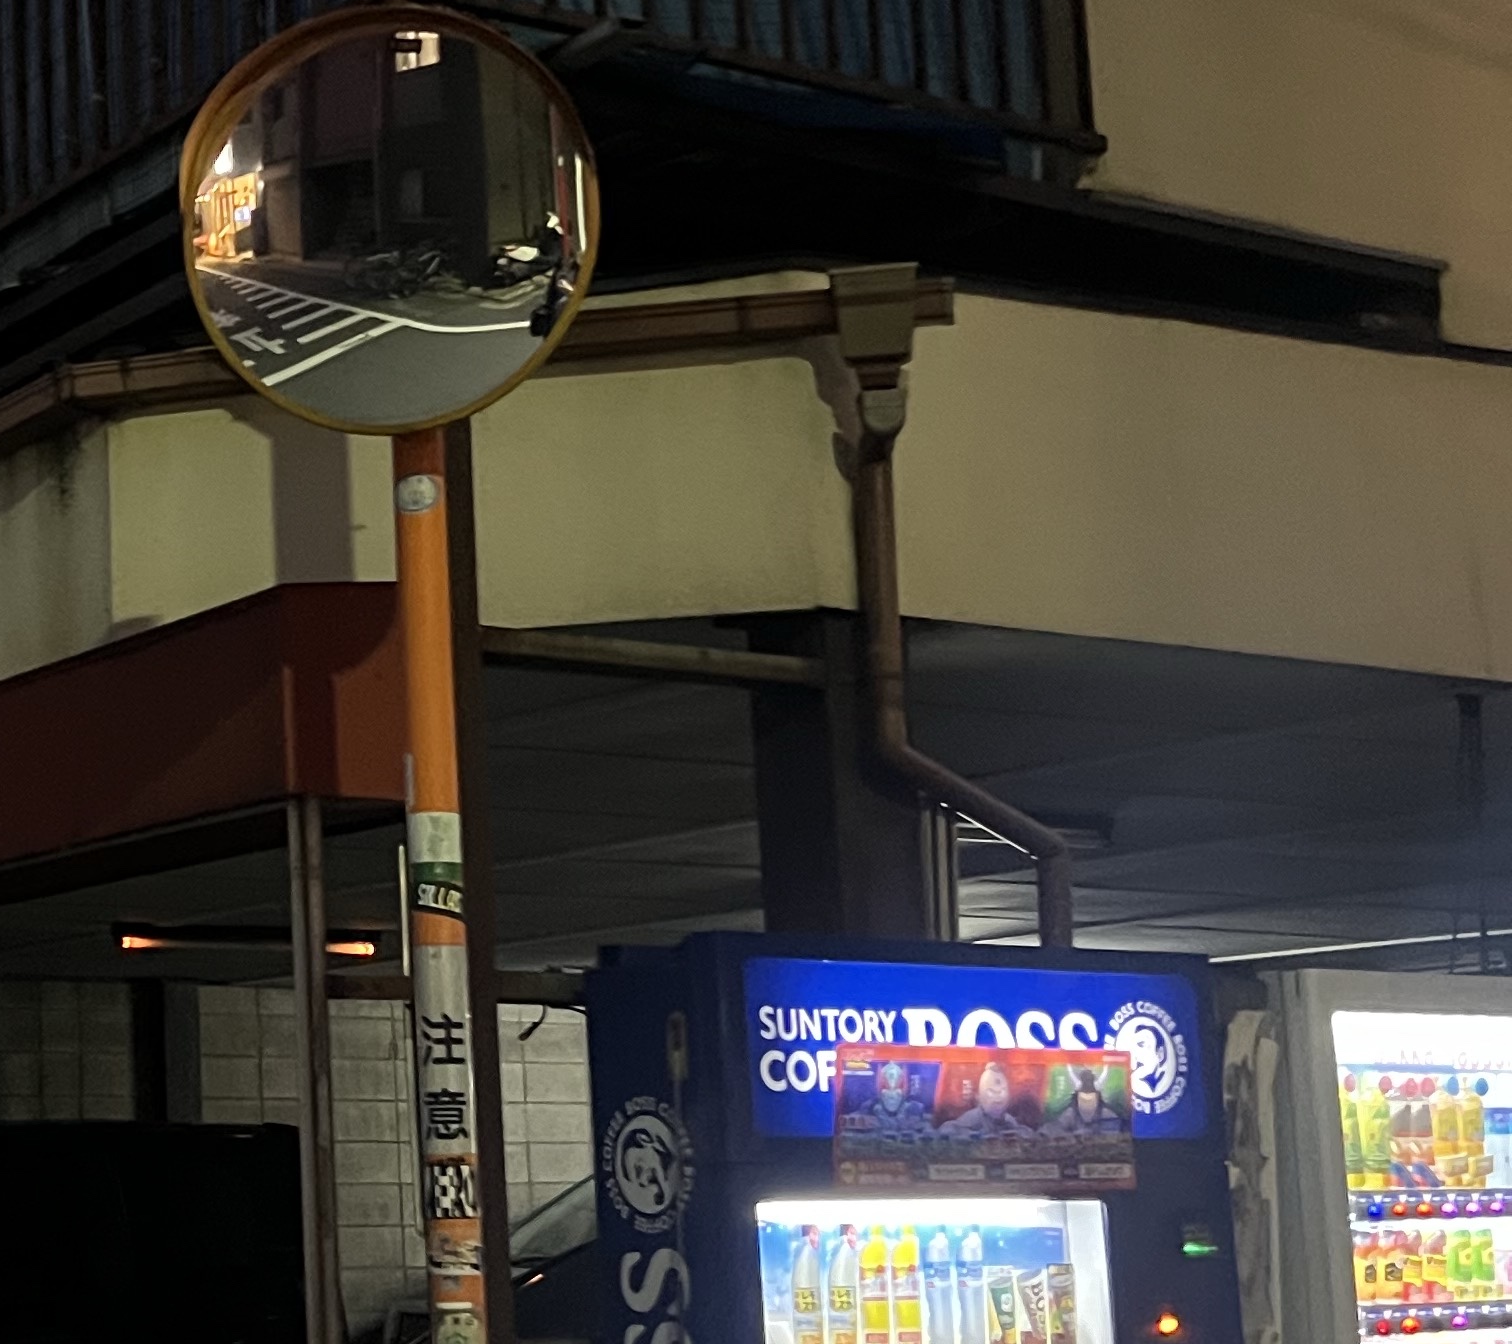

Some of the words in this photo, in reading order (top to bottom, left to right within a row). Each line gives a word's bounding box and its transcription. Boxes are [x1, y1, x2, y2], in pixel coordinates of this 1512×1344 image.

[759, 1006, 896, 1044] SUNTORY
[421, 1013, 470, 1141] 注意
[760, 1050, 836, 1092] COF
